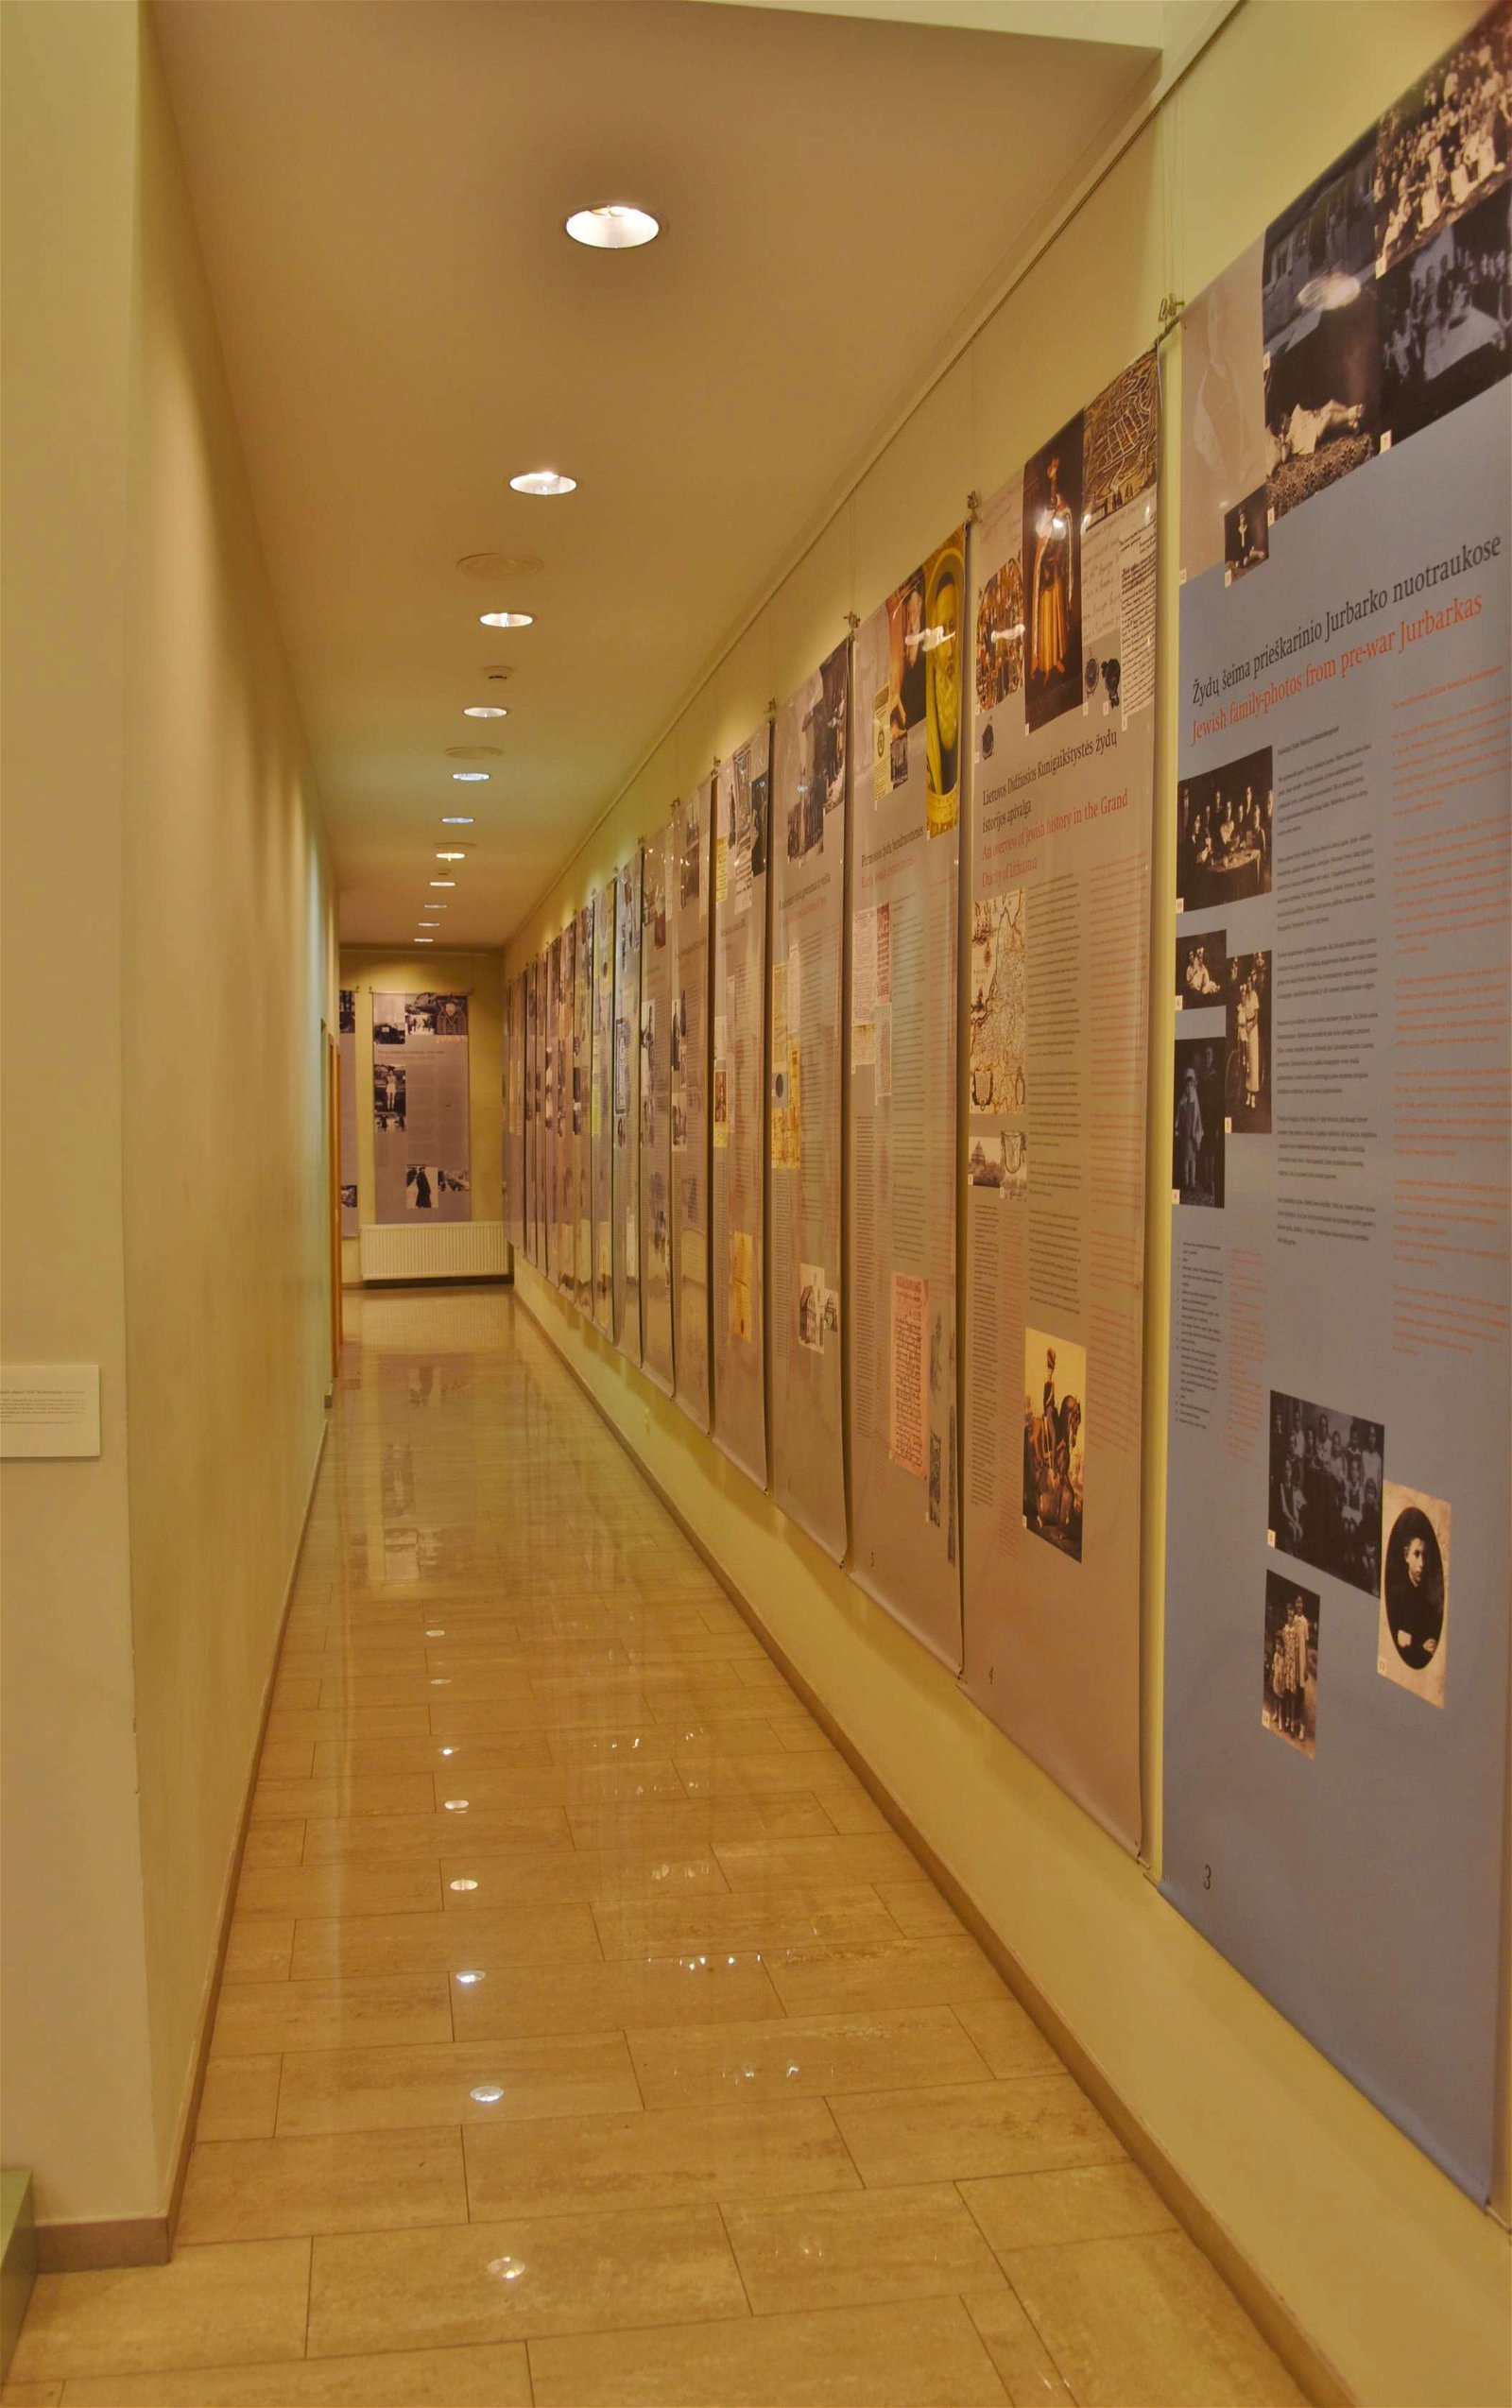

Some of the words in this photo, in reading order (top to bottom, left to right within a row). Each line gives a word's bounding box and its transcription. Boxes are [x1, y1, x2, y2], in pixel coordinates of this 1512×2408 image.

[1193, 676, 1220, 707] Žydų
[1222, 662, 1250, 690] šeima
[1253, 620, 1323, 679] prieškarinio
[1325, 589, 1387, 643] Jurbarko
[1393, 536, 1502, 604] nuotraukose
[1191, 706, 1227, 747] Jewish
[1305, 660, 1336, 688] from
[1341, 630, 1396, 679] pre-war
[1399, 594, 1483, 654] Jurbarkas
[1096, 729, 1117, 755] žydų
[1046, 814, 1072, 834] history
[1074, 806, 1082, 824] in
[1085, 801, 1098, 820] the
[1101, 788, 1128, 815] Grand
[1204, 1863, 1211, 1890] 3
